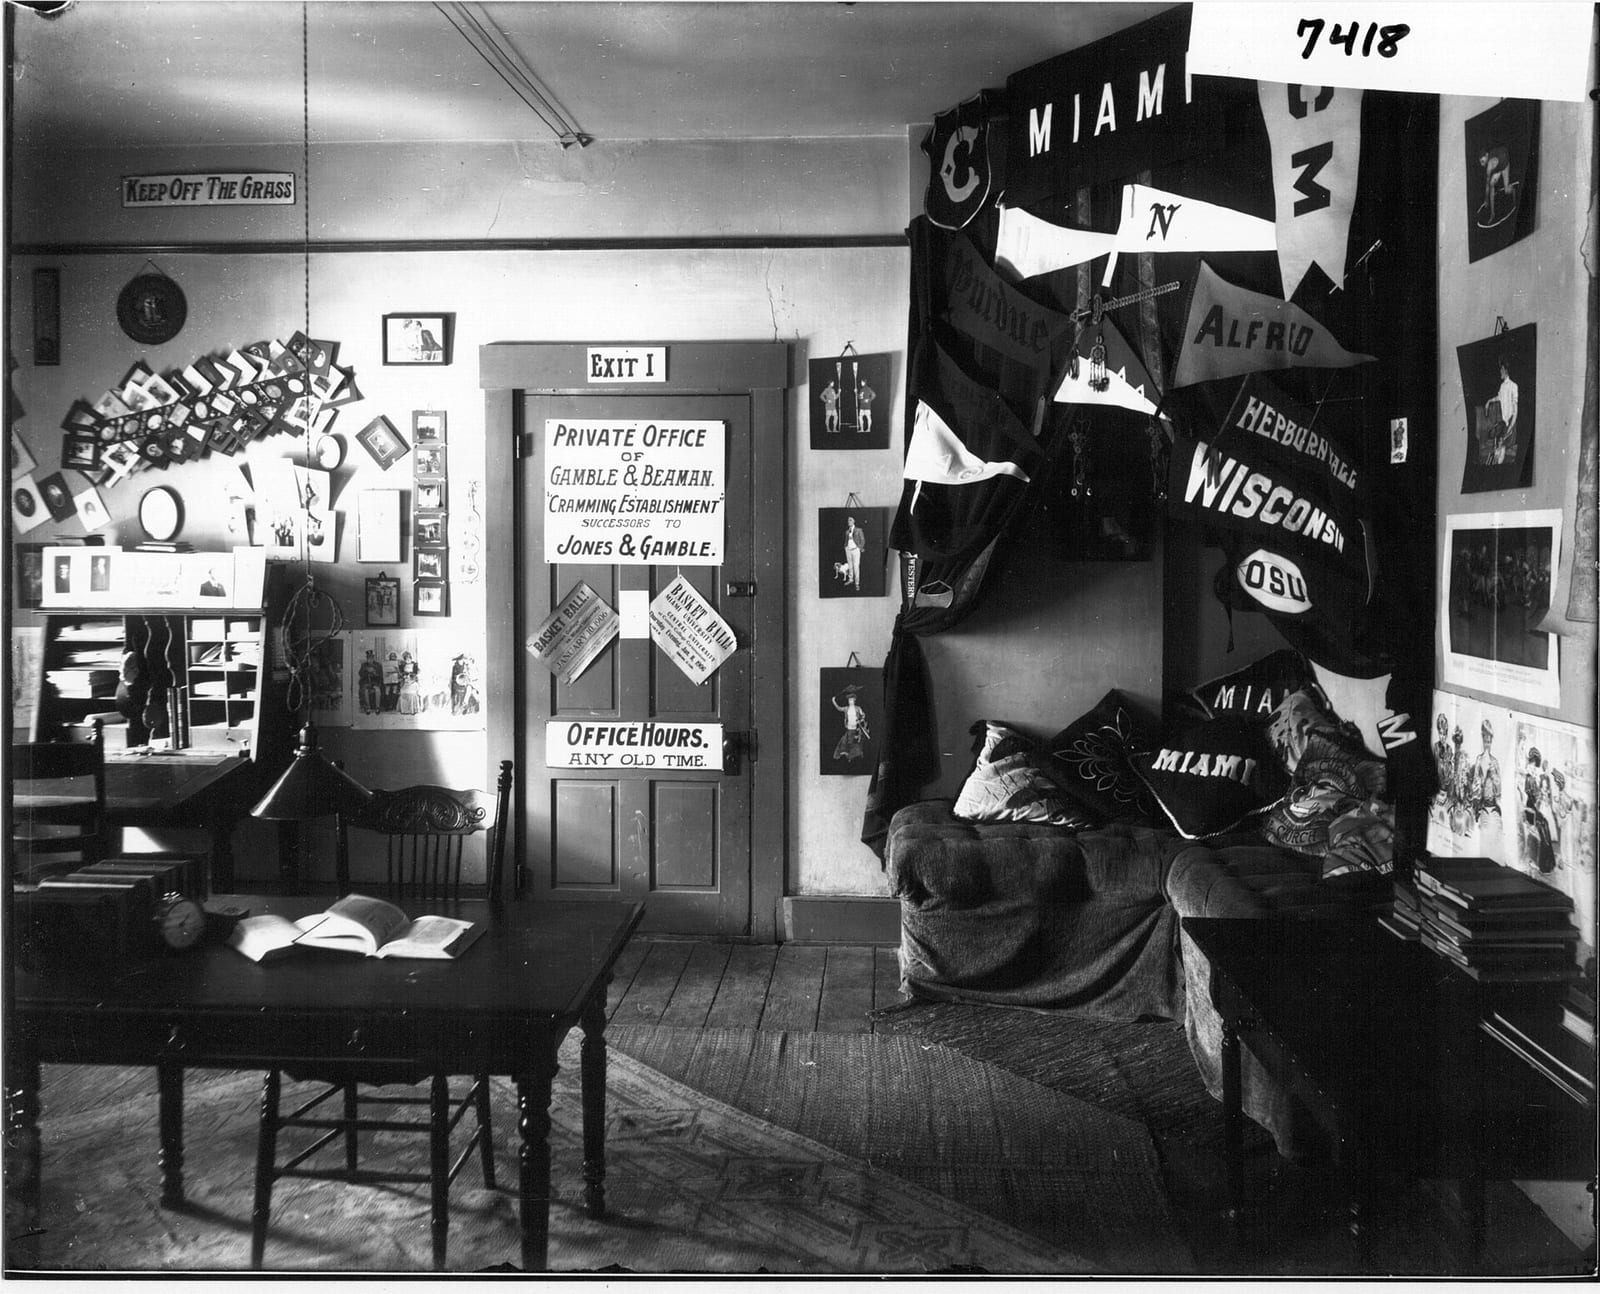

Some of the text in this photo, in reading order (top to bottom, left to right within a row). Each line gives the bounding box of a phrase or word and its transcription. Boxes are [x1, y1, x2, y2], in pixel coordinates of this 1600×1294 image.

[125, 176, 292, 202] KEEP OFF THE GRASS
[1146, 202, 1181, 240] N
[591, 353, 639, 378] EXIT
[553, 424, 707, 448] PRIVATE OFFICE
[1236, 395, 1330, 462] HEPBURN
[550, 464, 715, 487] GAMBLE & BEAMAN.
[621, 451, 644, 462] OF
[1184, 440, 1345, 554] WISCONSIN
[581, 518, 681, 528] SUCCESSORS TO
[557, 533, 716, 560] JONES & GAMBLE.
[907, 558, 916, 598] WESTERN
[1246, 559, 1306, 602] OSU
[533, 590, 589, 652] BASKET BALL!
[664, 593, 681, 612] MIAMI
[682, 613, 713, 644] UNIVERSITY
[670, 583, 708, 622] BASKET
[554, 632, 587, 670] JANUARY
[593, 610, 608, 626] 1906
[666, 610, 687, 633] CENTRAL
[687, 633, 715, 662] UNIVERSITY
[567, 722, 708, 749] OFFICE HOURS.
[568, 753, 707, 767] ANY OLD TIME.
[1152, 748, 1256, 786] MIAMI
